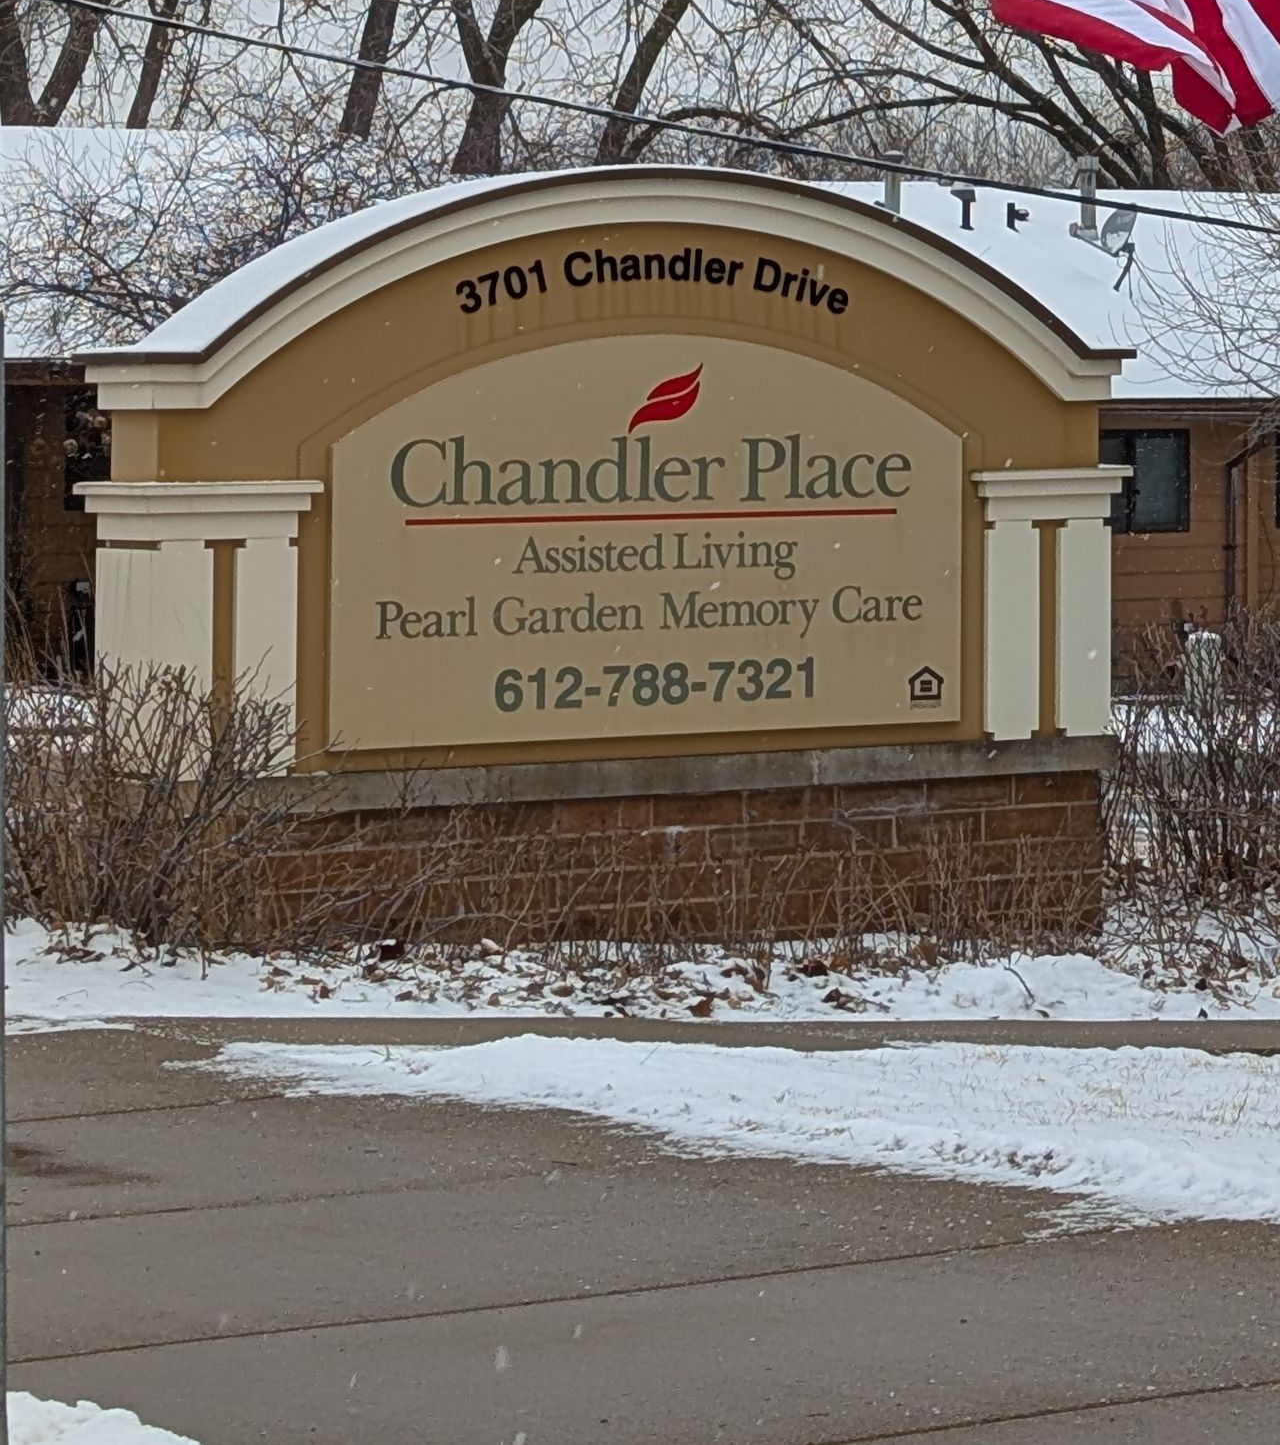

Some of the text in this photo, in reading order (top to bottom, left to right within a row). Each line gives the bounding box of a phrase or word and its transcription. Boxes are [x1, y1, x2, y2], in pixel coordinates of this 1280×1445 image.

[455, 248, 850, 315] 3701 Chandler Drive
[390, 433, 912, 508] Chandler Place
[512, 531, 798, 581] Assisted Living
[375, 585, 923, 640] Pearl Garden Memory Care
[494, 656, 815, 713] 612-788-7321
